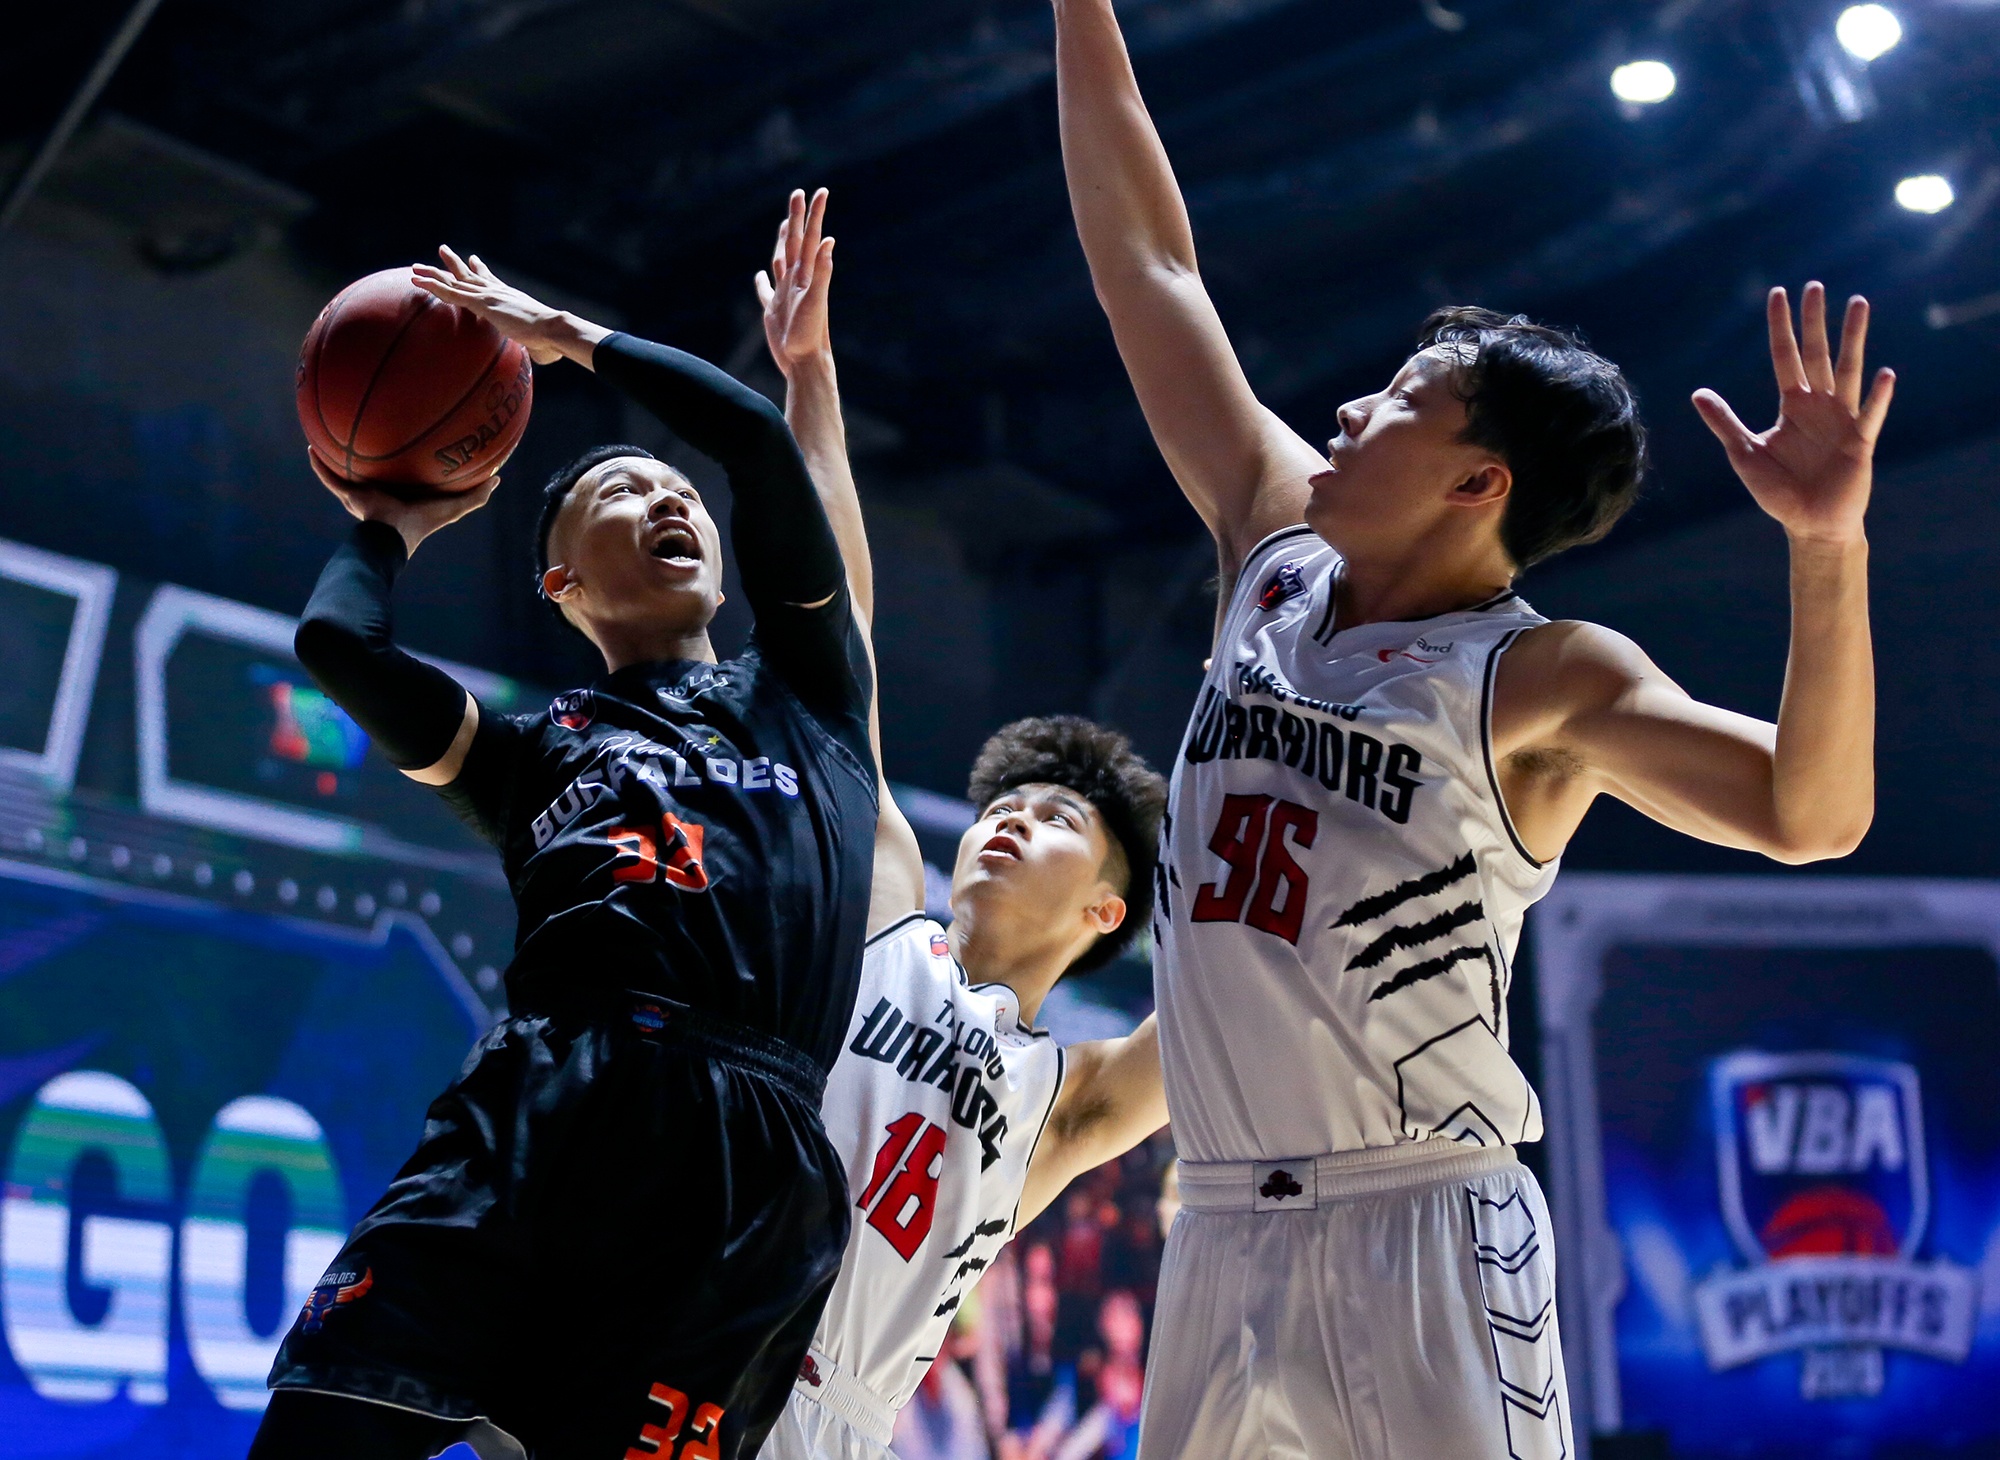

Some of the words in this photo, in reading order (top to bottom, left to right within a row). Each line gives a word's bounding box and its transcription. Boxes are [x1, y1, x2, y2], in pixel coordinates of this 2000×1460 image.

[556, 690, 589, 711] VBA
[1185, 685, 1425, 824] WARRIORS
[531, 756, 800, 850] BUFFALOES
[1191, 792, 1319, 947] 96
[856, 1112, 947, 1263] 18
[1748, 1085, 1903, 1174] VBA
[1, 1069, 348, 1412] GO
[622, 1381, 725, 1460] 32
